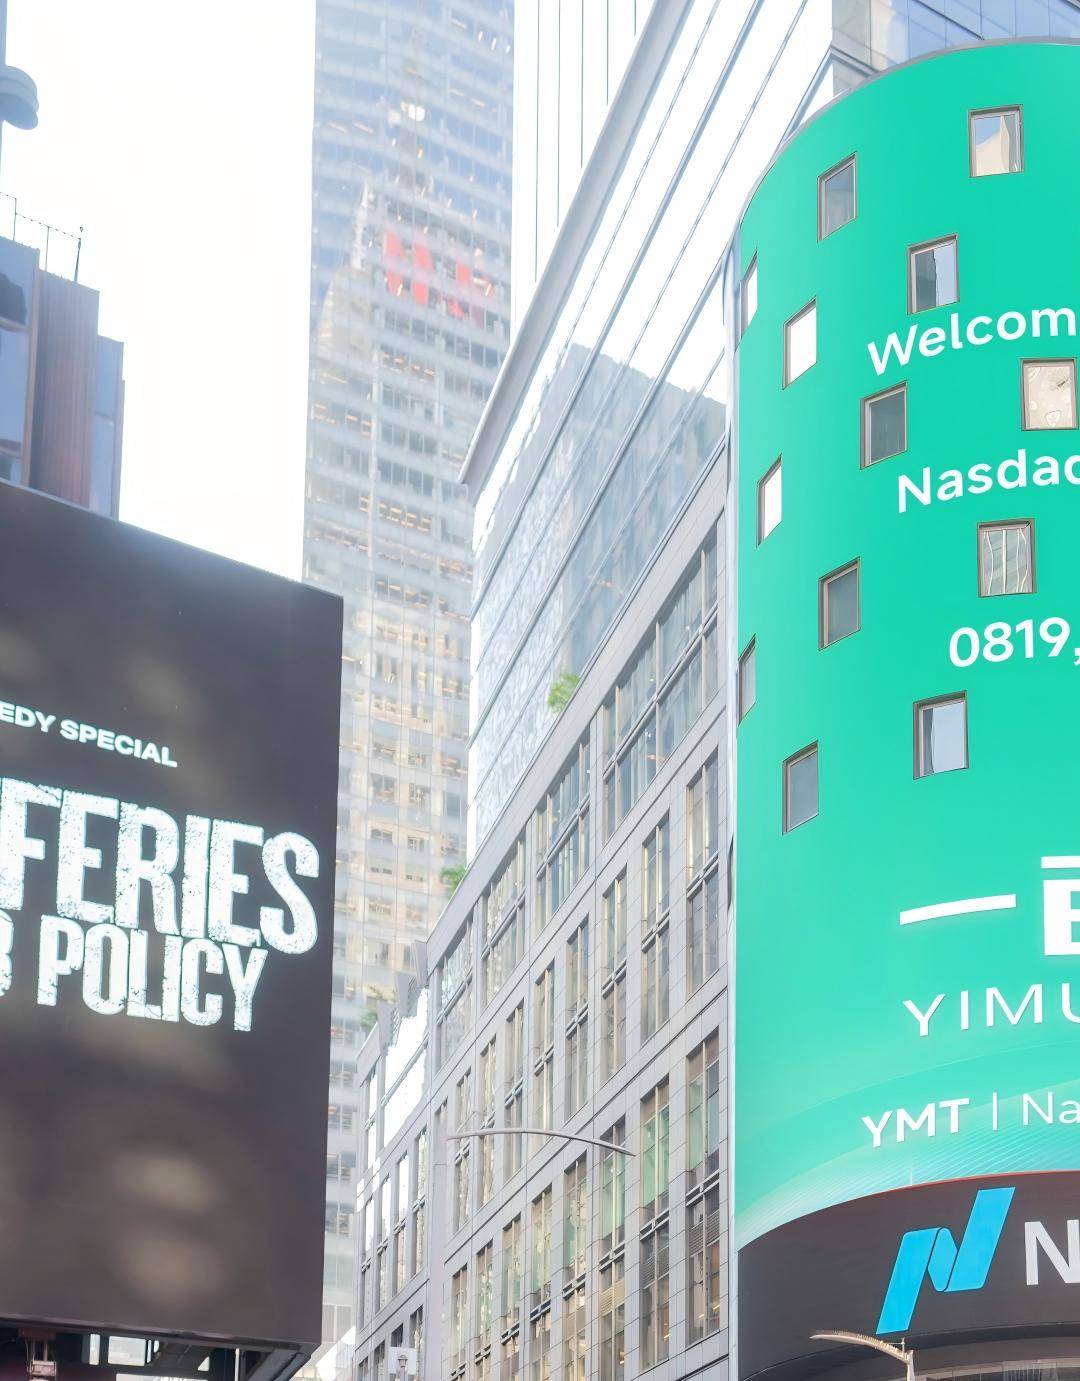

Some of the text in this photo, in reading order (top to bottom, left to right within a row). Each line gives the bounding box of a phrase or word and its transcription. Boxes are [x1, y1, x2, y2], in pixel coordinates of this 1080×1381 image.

[60, 719, 178, 768] SPECIAL
[37, 914, 269, 1032] POLICY
[861, 1097, 970, 1148] YMT
